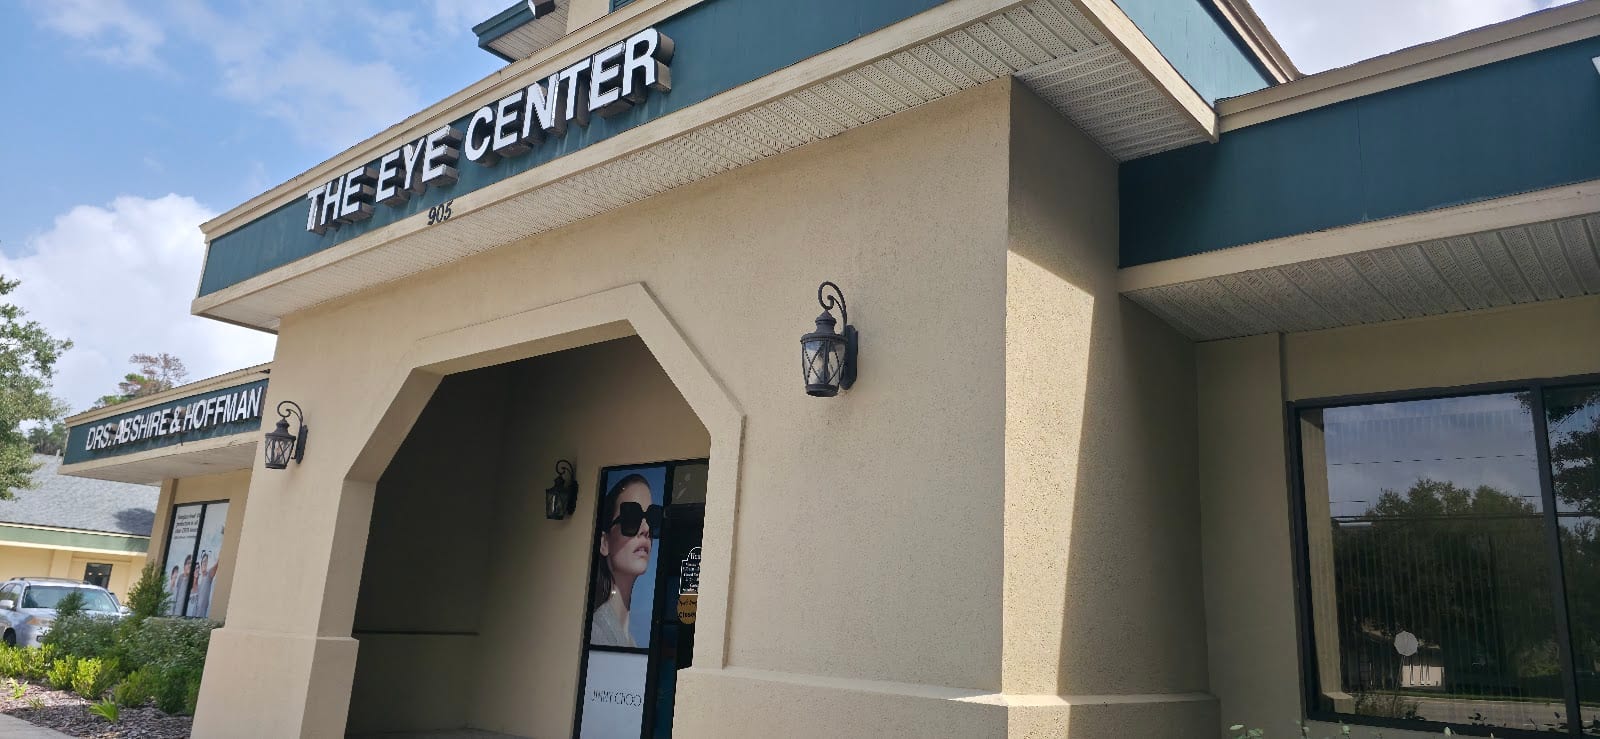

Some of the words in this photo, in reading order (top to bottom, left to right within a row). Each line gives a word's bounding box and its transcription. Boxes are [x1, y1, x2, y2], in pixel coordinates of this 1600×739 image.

[306, 166, 372, 233] THE
[376, 125, 456, 203] EYE
[464, 28, 666, 162] CENTER
[427, 202, 453, 225] 905
[85, 423, 114, 451] DRS.
[113, 409, 170, 445] ABSHIRE
[169, 406, 182, 433] &
[183, 386, 262, 431] HOFFMAN
